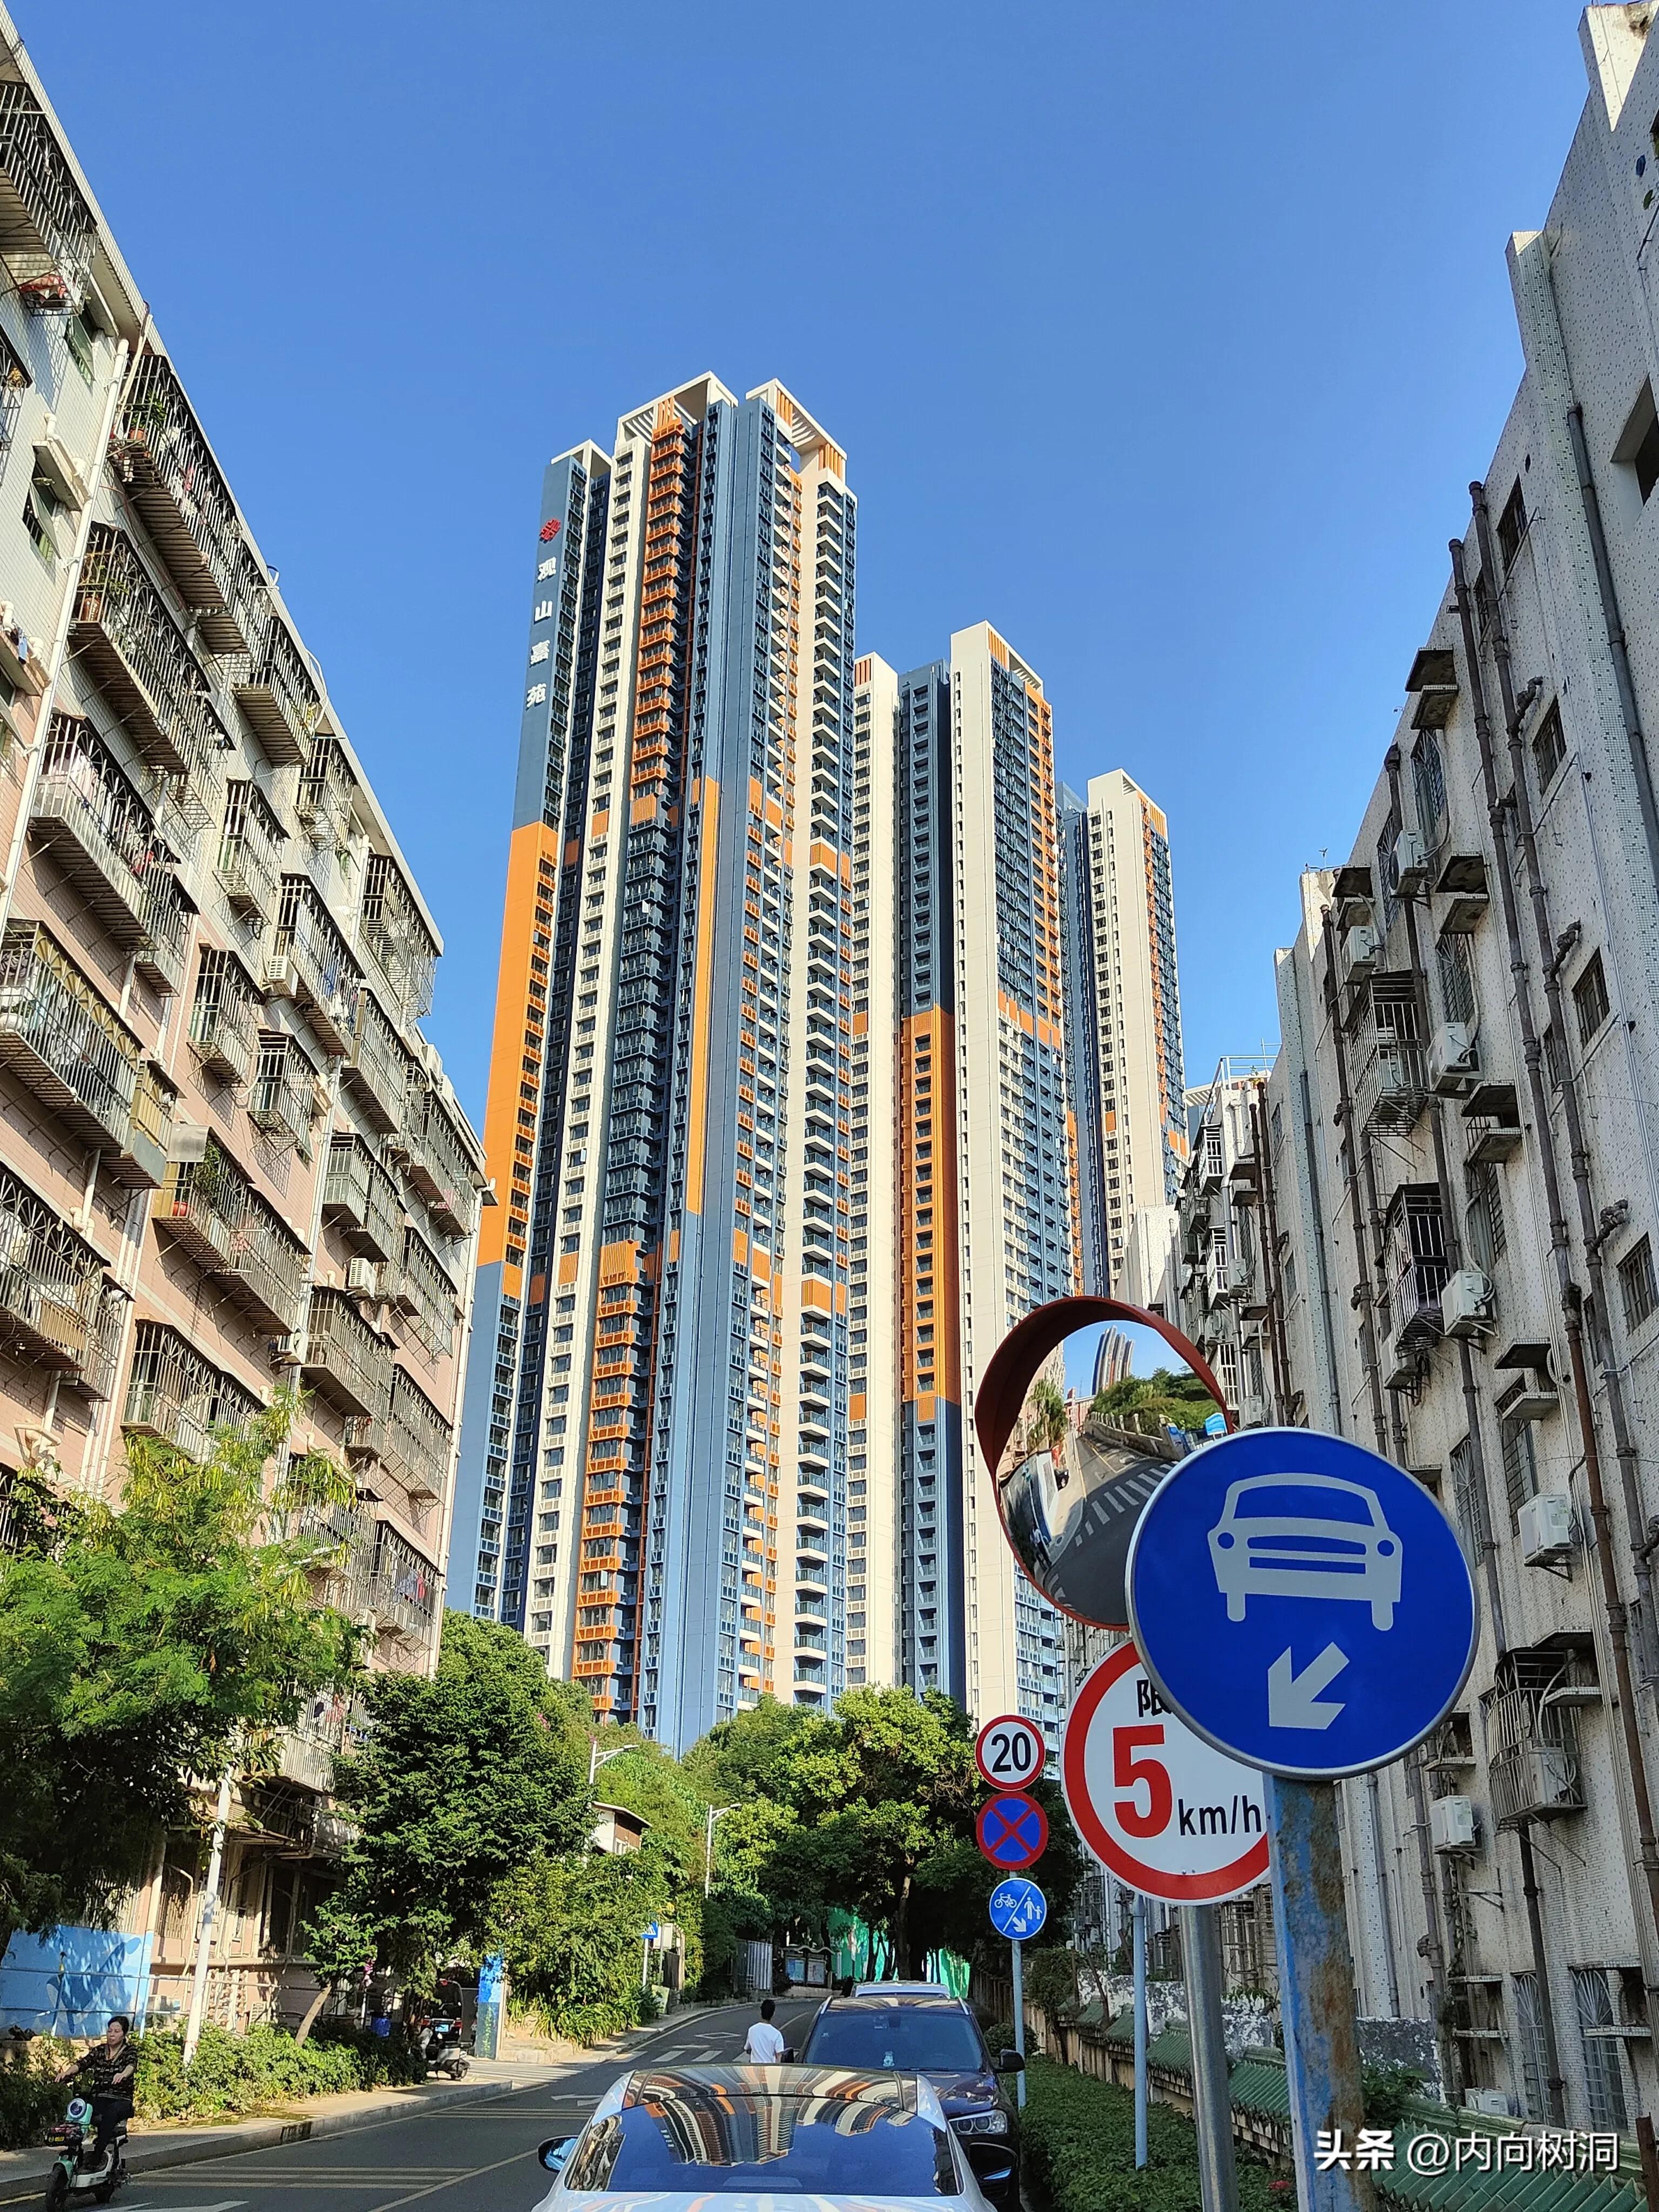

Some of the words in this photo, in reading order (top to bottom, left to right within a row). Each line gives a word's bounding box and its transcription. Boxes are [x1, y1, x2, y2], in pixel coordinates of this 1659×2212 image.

[527, 557, 556, 707] 观山嘉苑
[991, 1732, 1031, 1773] 20
[1112, 1724, 1172, 1838] 5
[1178, 1795, 1262, 1836] km/h
